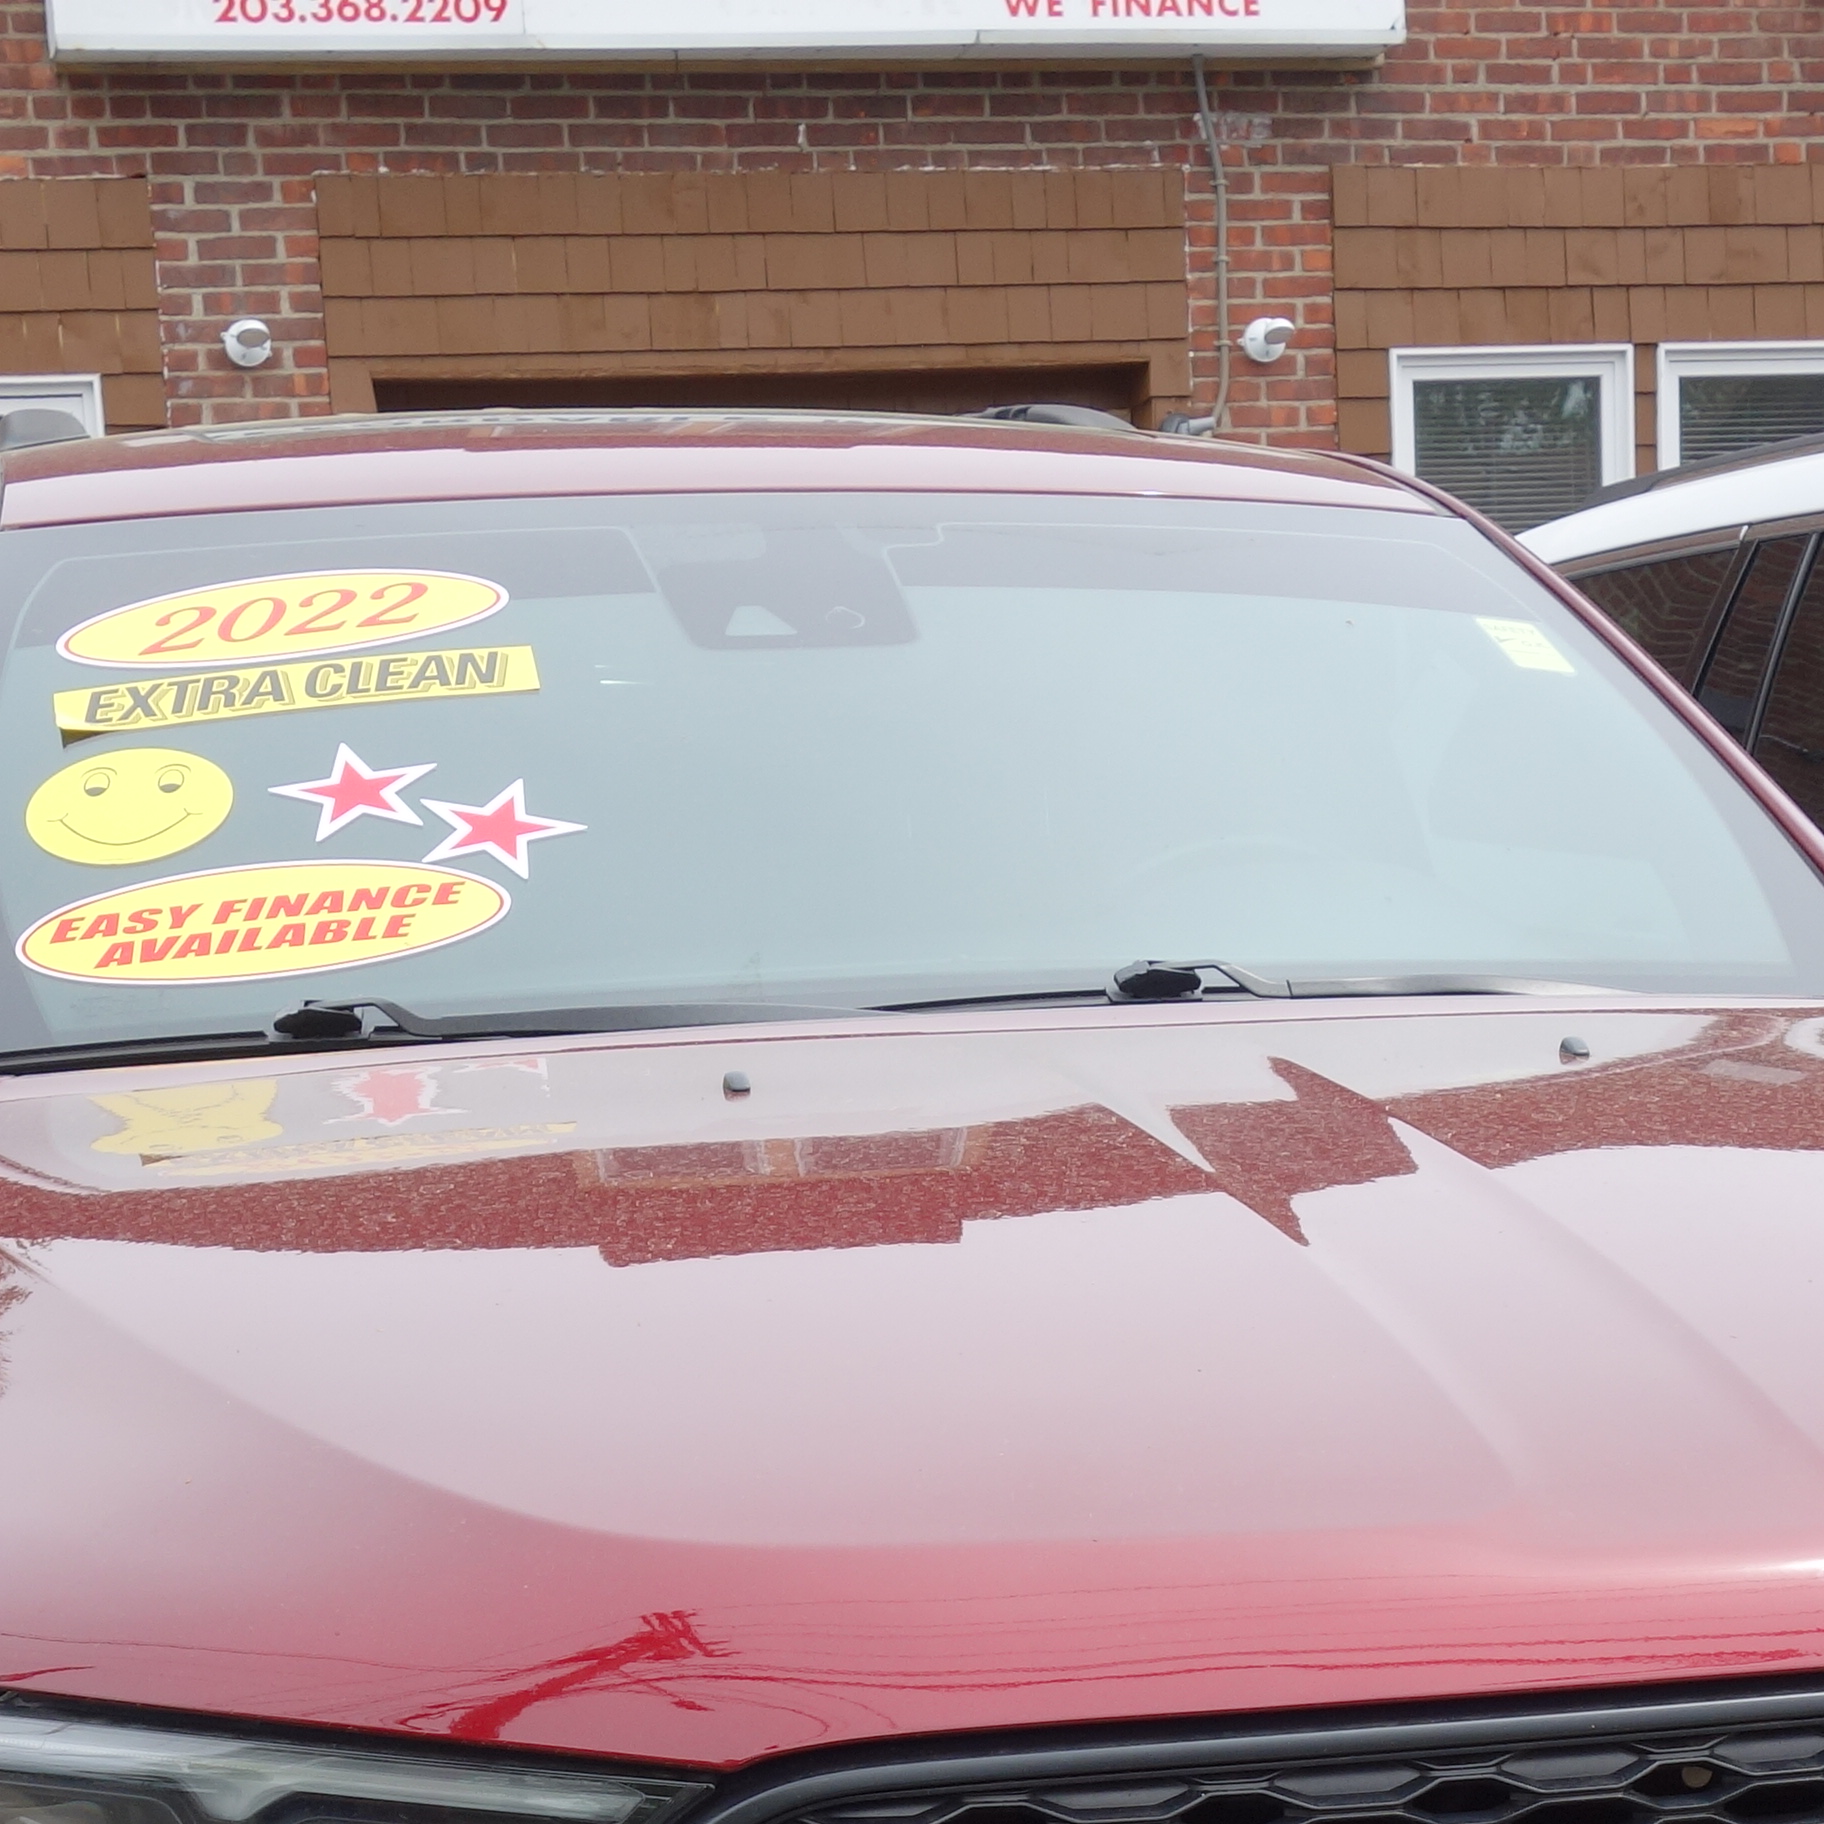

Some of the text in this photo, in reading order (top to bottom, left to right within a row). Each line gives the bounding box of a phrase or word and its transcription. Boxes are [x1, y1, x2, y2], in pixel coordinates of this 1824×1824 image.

[212, 0, 508, 23] 203.368.2209
[1005, 0, 1261, 17] WE FINANCE
[138, 581, 429, 657] 2022
[83, 650, 509, 728] EXTRA CLEAN
[49, 881, 466, 945] EASY FINANCE
[92, 912, 418, 970] AVAILABLE
